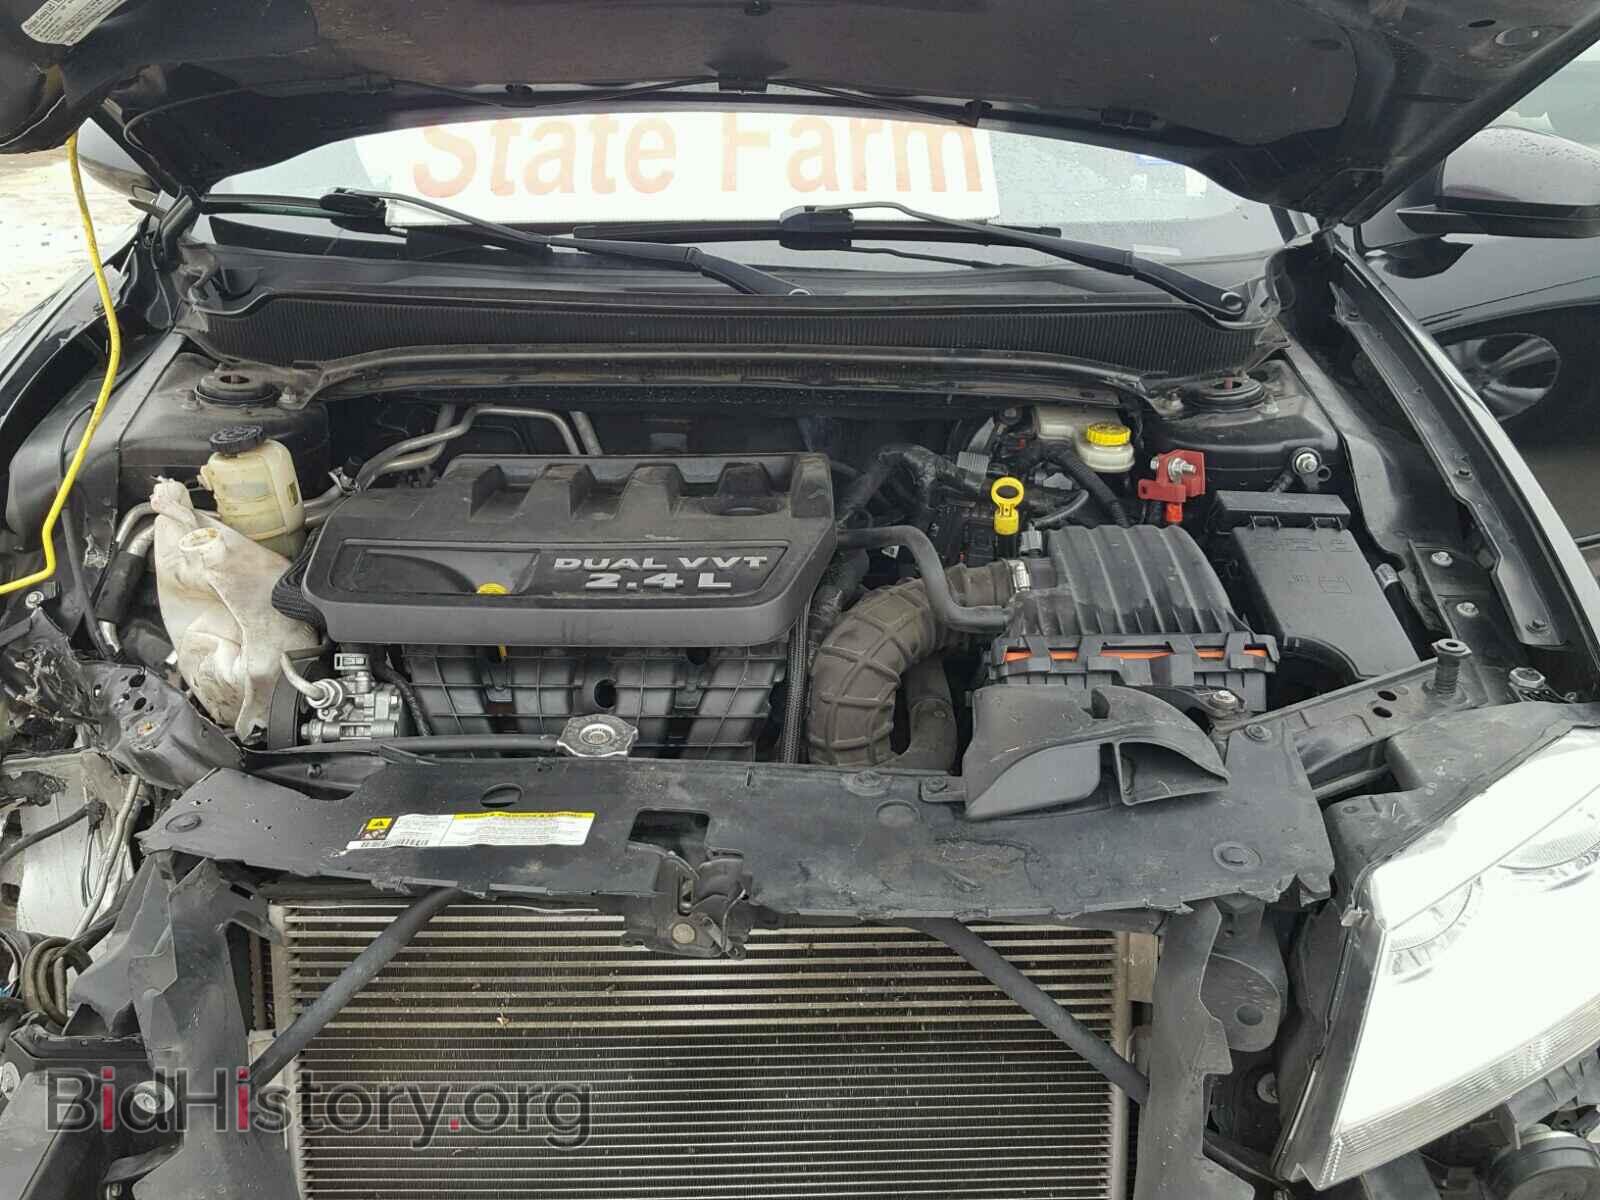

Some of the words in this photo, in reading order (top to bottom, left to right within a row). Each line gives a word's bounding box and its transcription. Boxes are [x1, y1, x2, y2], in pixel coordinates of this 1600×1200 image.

[413, 113, 677, 198] State
[721, 112, 984, 193] Farm
[553, 557, 668, 570] DUAL
[677, 556, 768, 569] VVT
